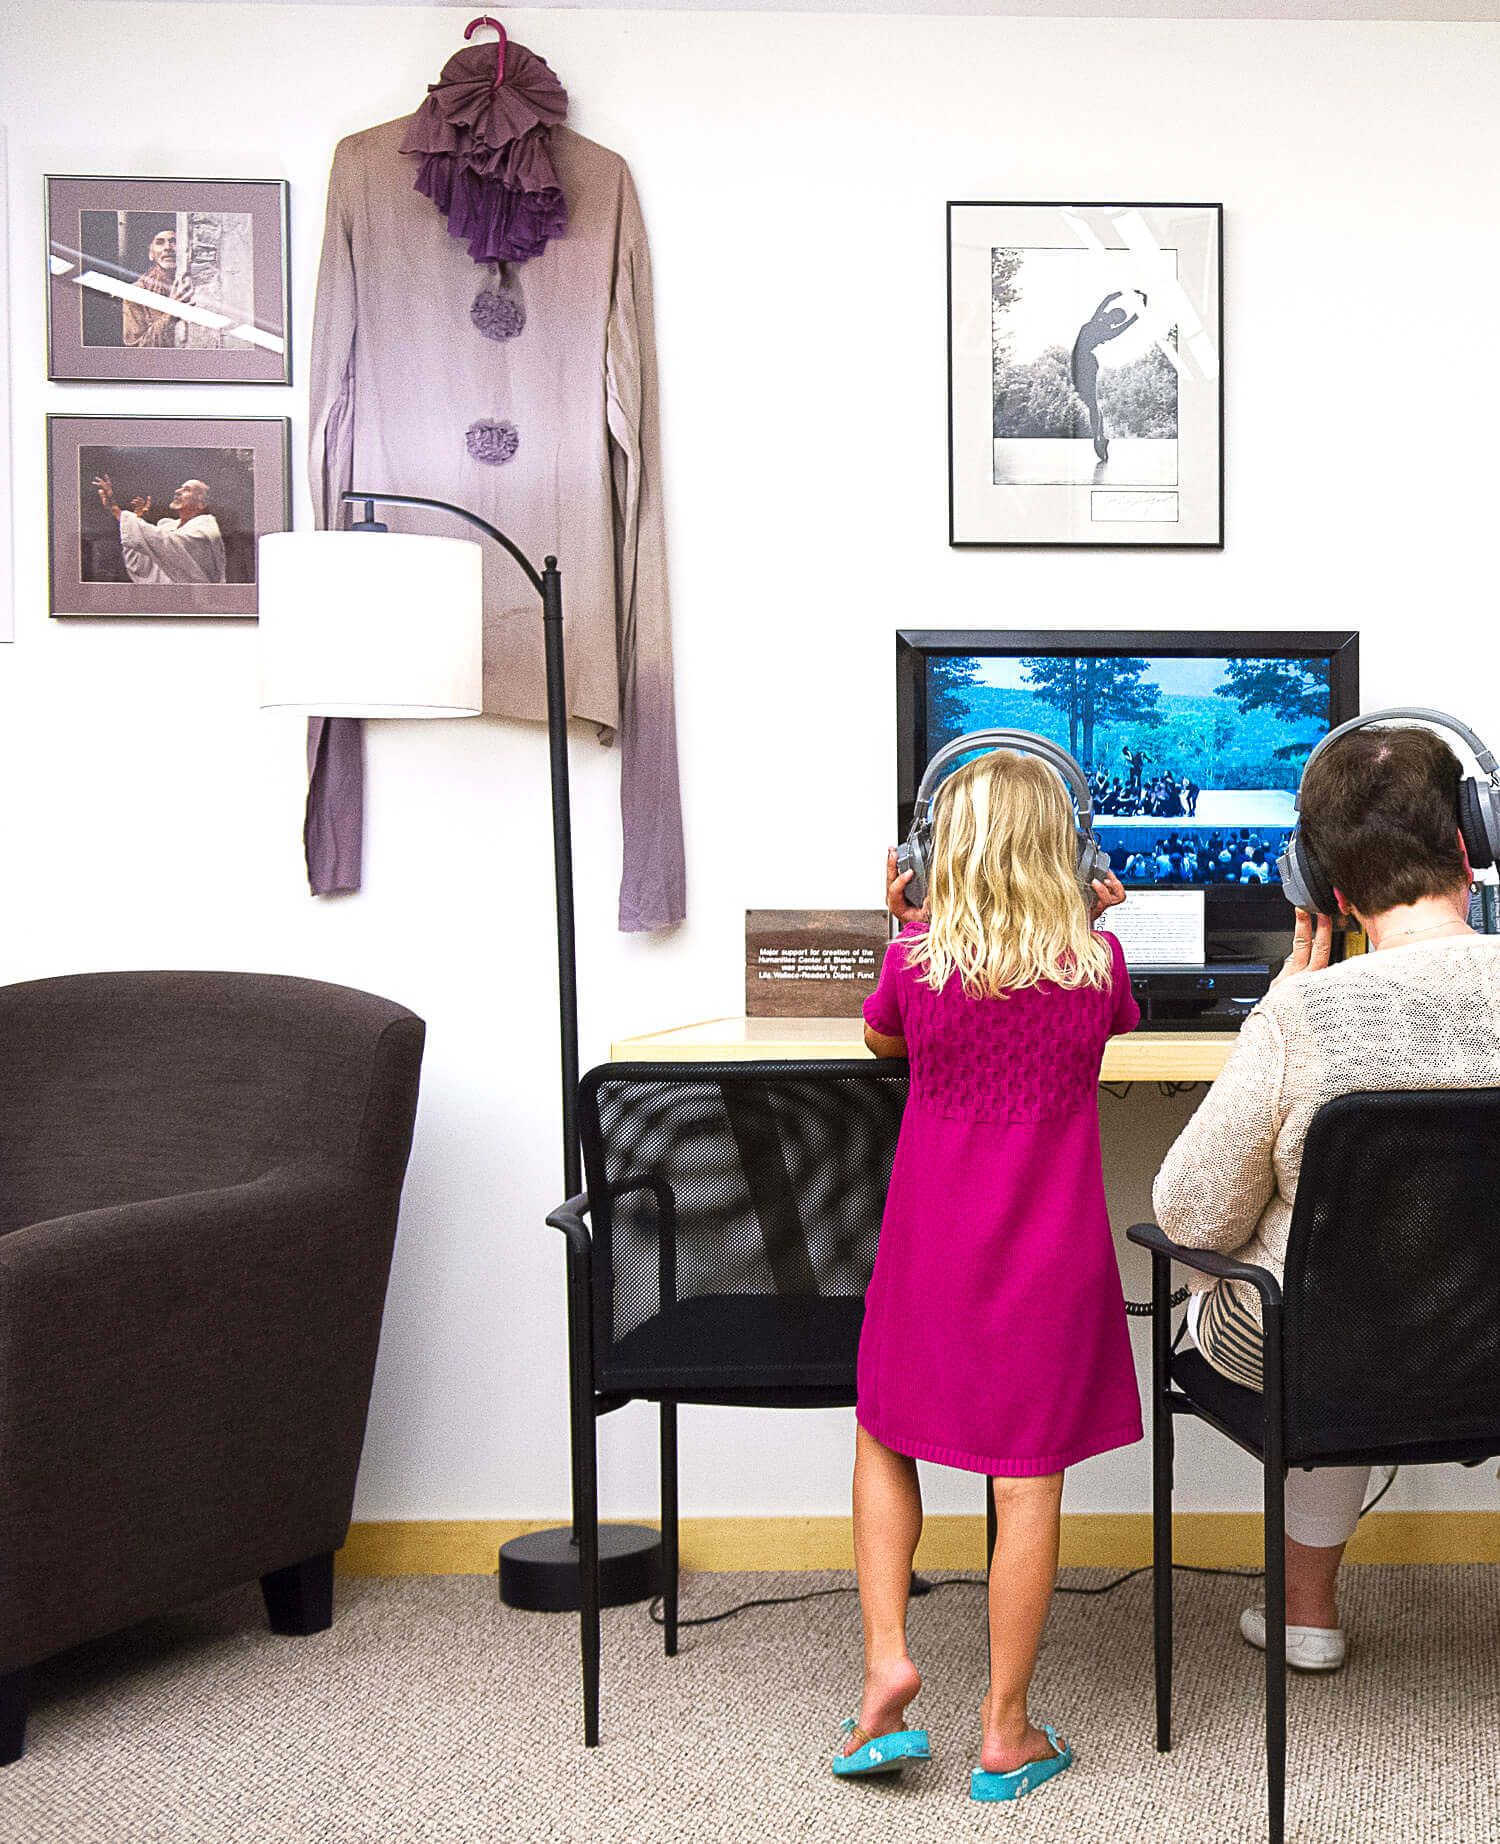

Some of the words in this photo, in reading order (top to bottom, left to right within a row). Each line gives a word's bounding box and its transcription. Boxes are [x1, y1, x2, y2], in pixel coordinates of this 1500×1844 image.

[759, 949, 779, 957] Major
[781, 949, 808, 957] support
[758, 956, 796, 964] Humanities
[798, 956, 822, 964] Center
[823, 956, 831, 964] at
[858, 956, 875, 964] Barn
[797, 964, 828, 973] provided
[829, 964, 839, 974] by
[840, 964, 852, 972] the
[832, 972, 855, 980] Digest
